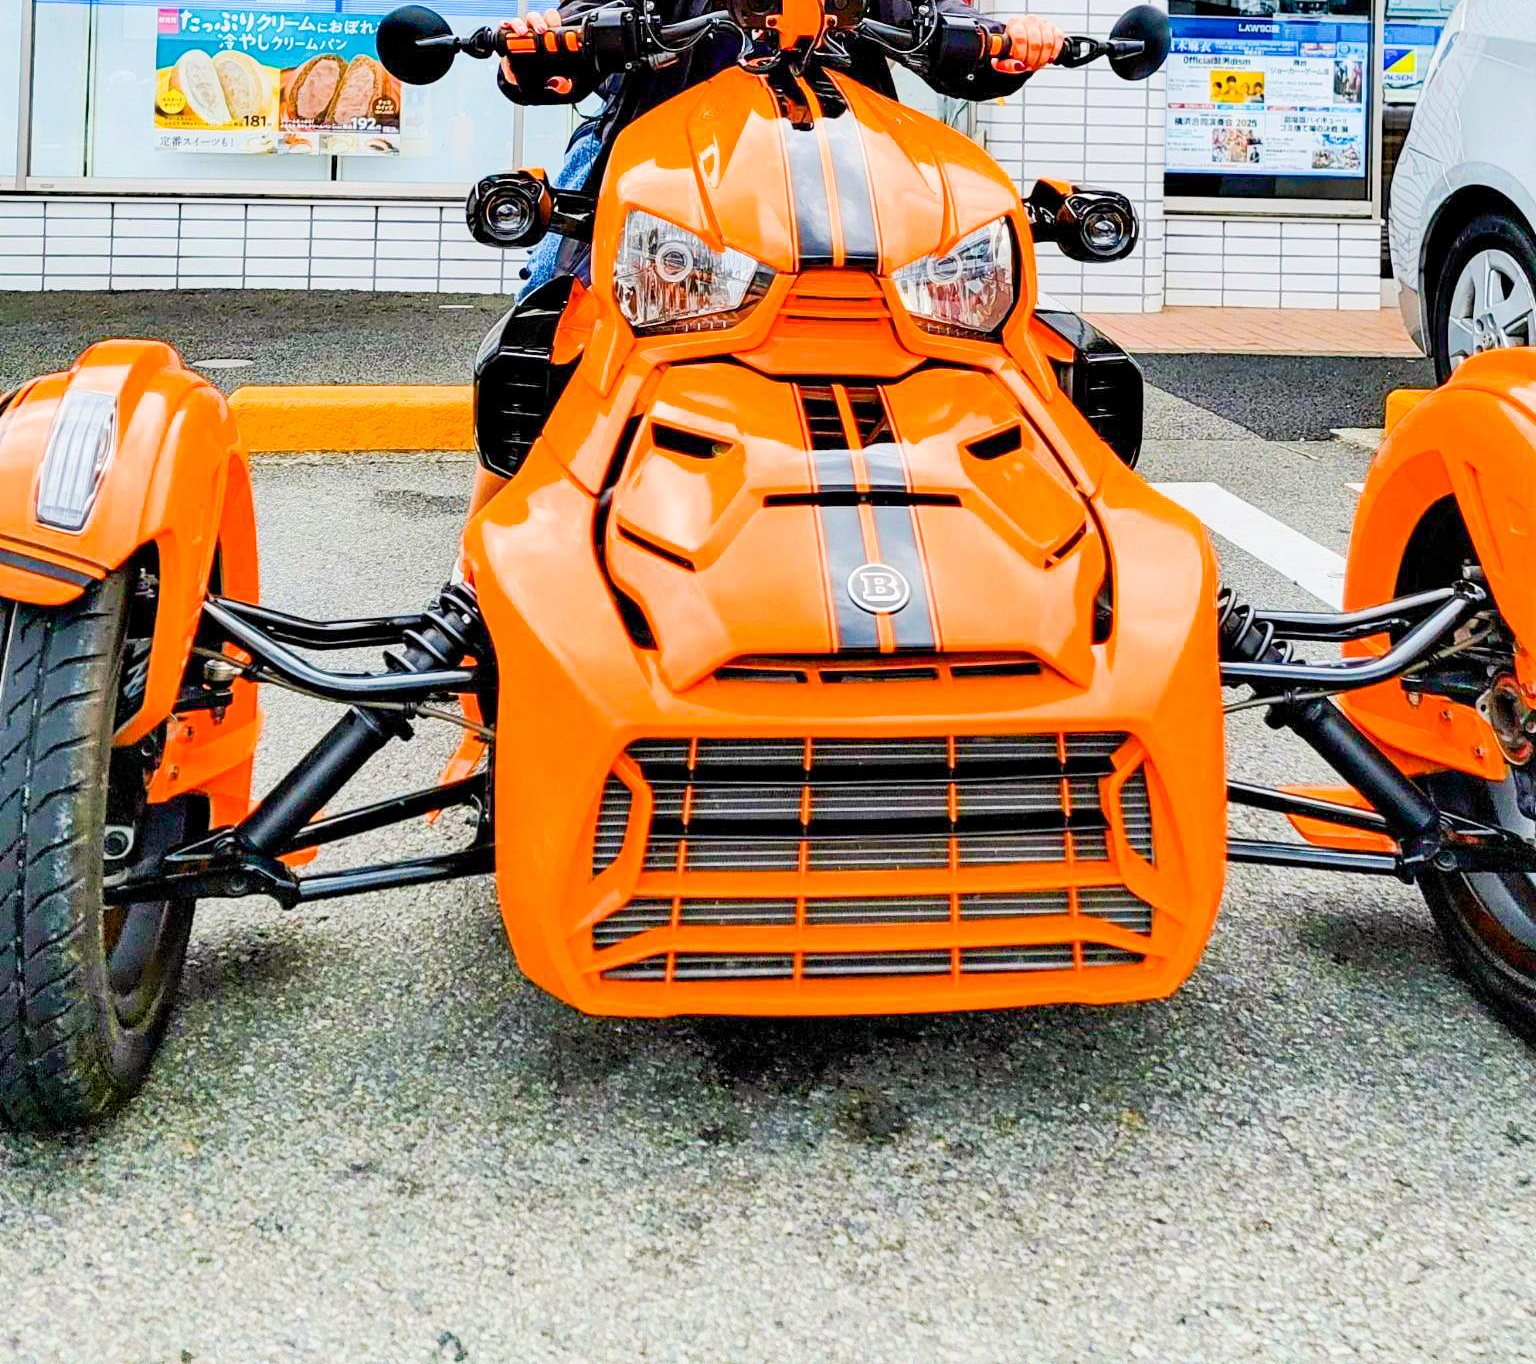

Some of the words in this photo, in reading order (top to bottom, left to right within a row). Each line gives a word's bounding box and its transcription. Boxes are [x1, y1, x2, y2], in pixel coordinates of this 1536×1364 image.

[217, 33, 347, 51] 冷やしクリームパン
[1236, 119, 1258, 128] 2025
[859, 572, 901, 602] B
